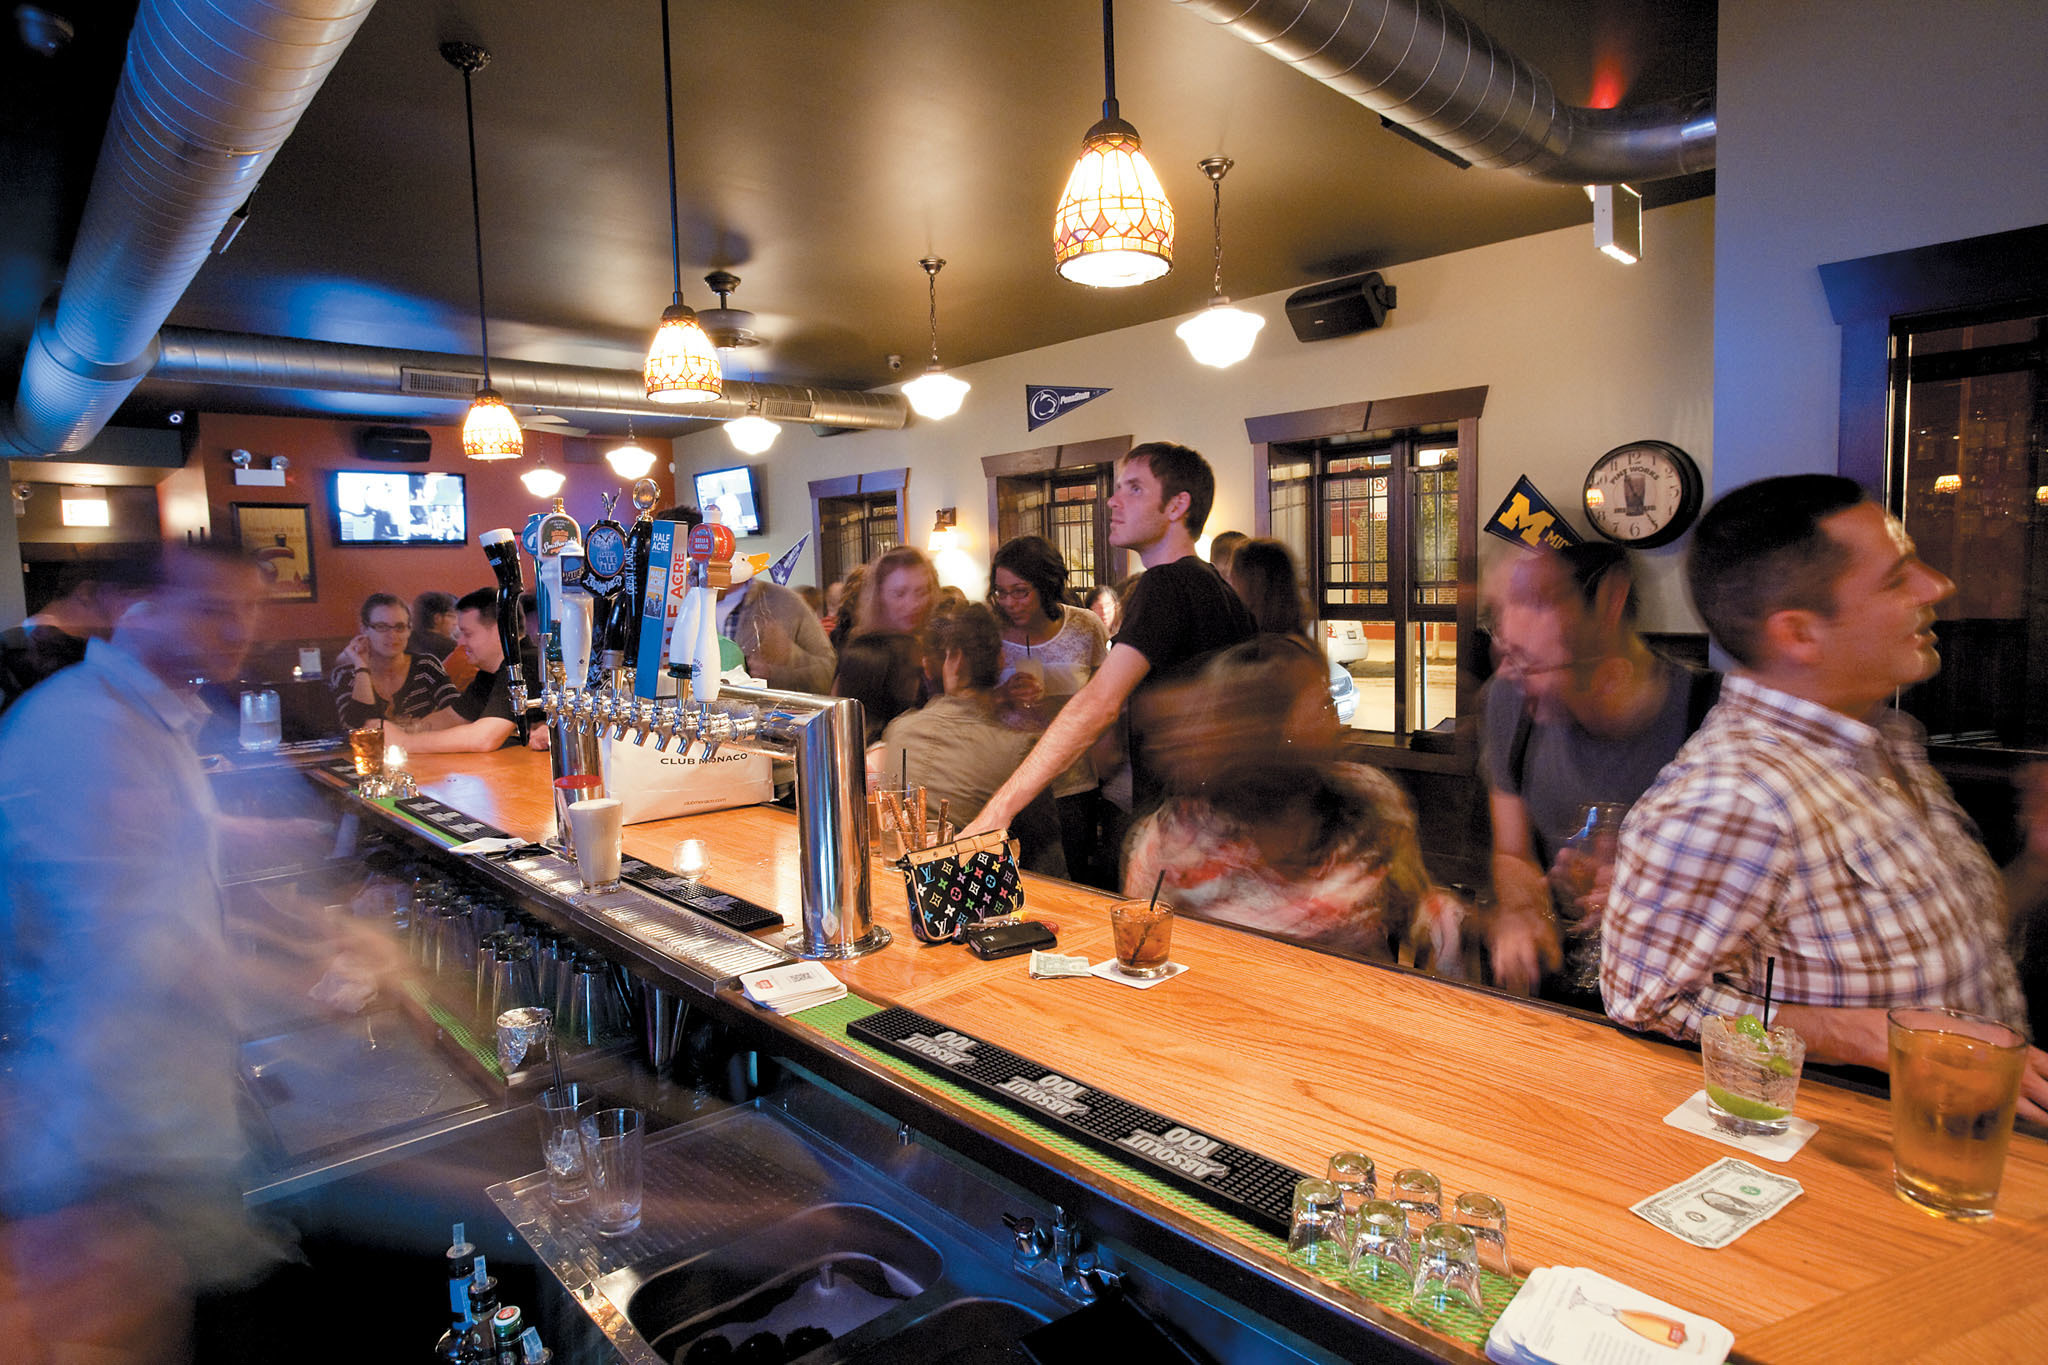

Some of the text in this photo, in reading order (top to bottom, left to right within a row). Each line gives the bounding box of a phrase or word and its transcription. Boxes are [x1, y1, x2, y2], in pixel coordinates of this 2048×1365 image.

[1628, 452, 1641, 465] 12
[1629, 466, 1660, 481] WORKS
[1497, 492, 1556, 547] M
[1629, 523, 1641, 537] 6
[651, 542, 670, 552] ACRE
[652, 532, 671, 543] HALF
[624, 547, 635, 596] GREAT LAKES
[670, 552, 685, 600] ACRE
[896, 1036, 963, 1066] ABSOLUT
[934, 1031, 978, 1052] 100
[995, 1079, 1076, 1115] ABSOLUT
[1038, 1074, 1089, 1099] 100
[1164, 1127, 1221, 1157] 100
[1117, 1134, 1214, 1178] ABSOLUT
